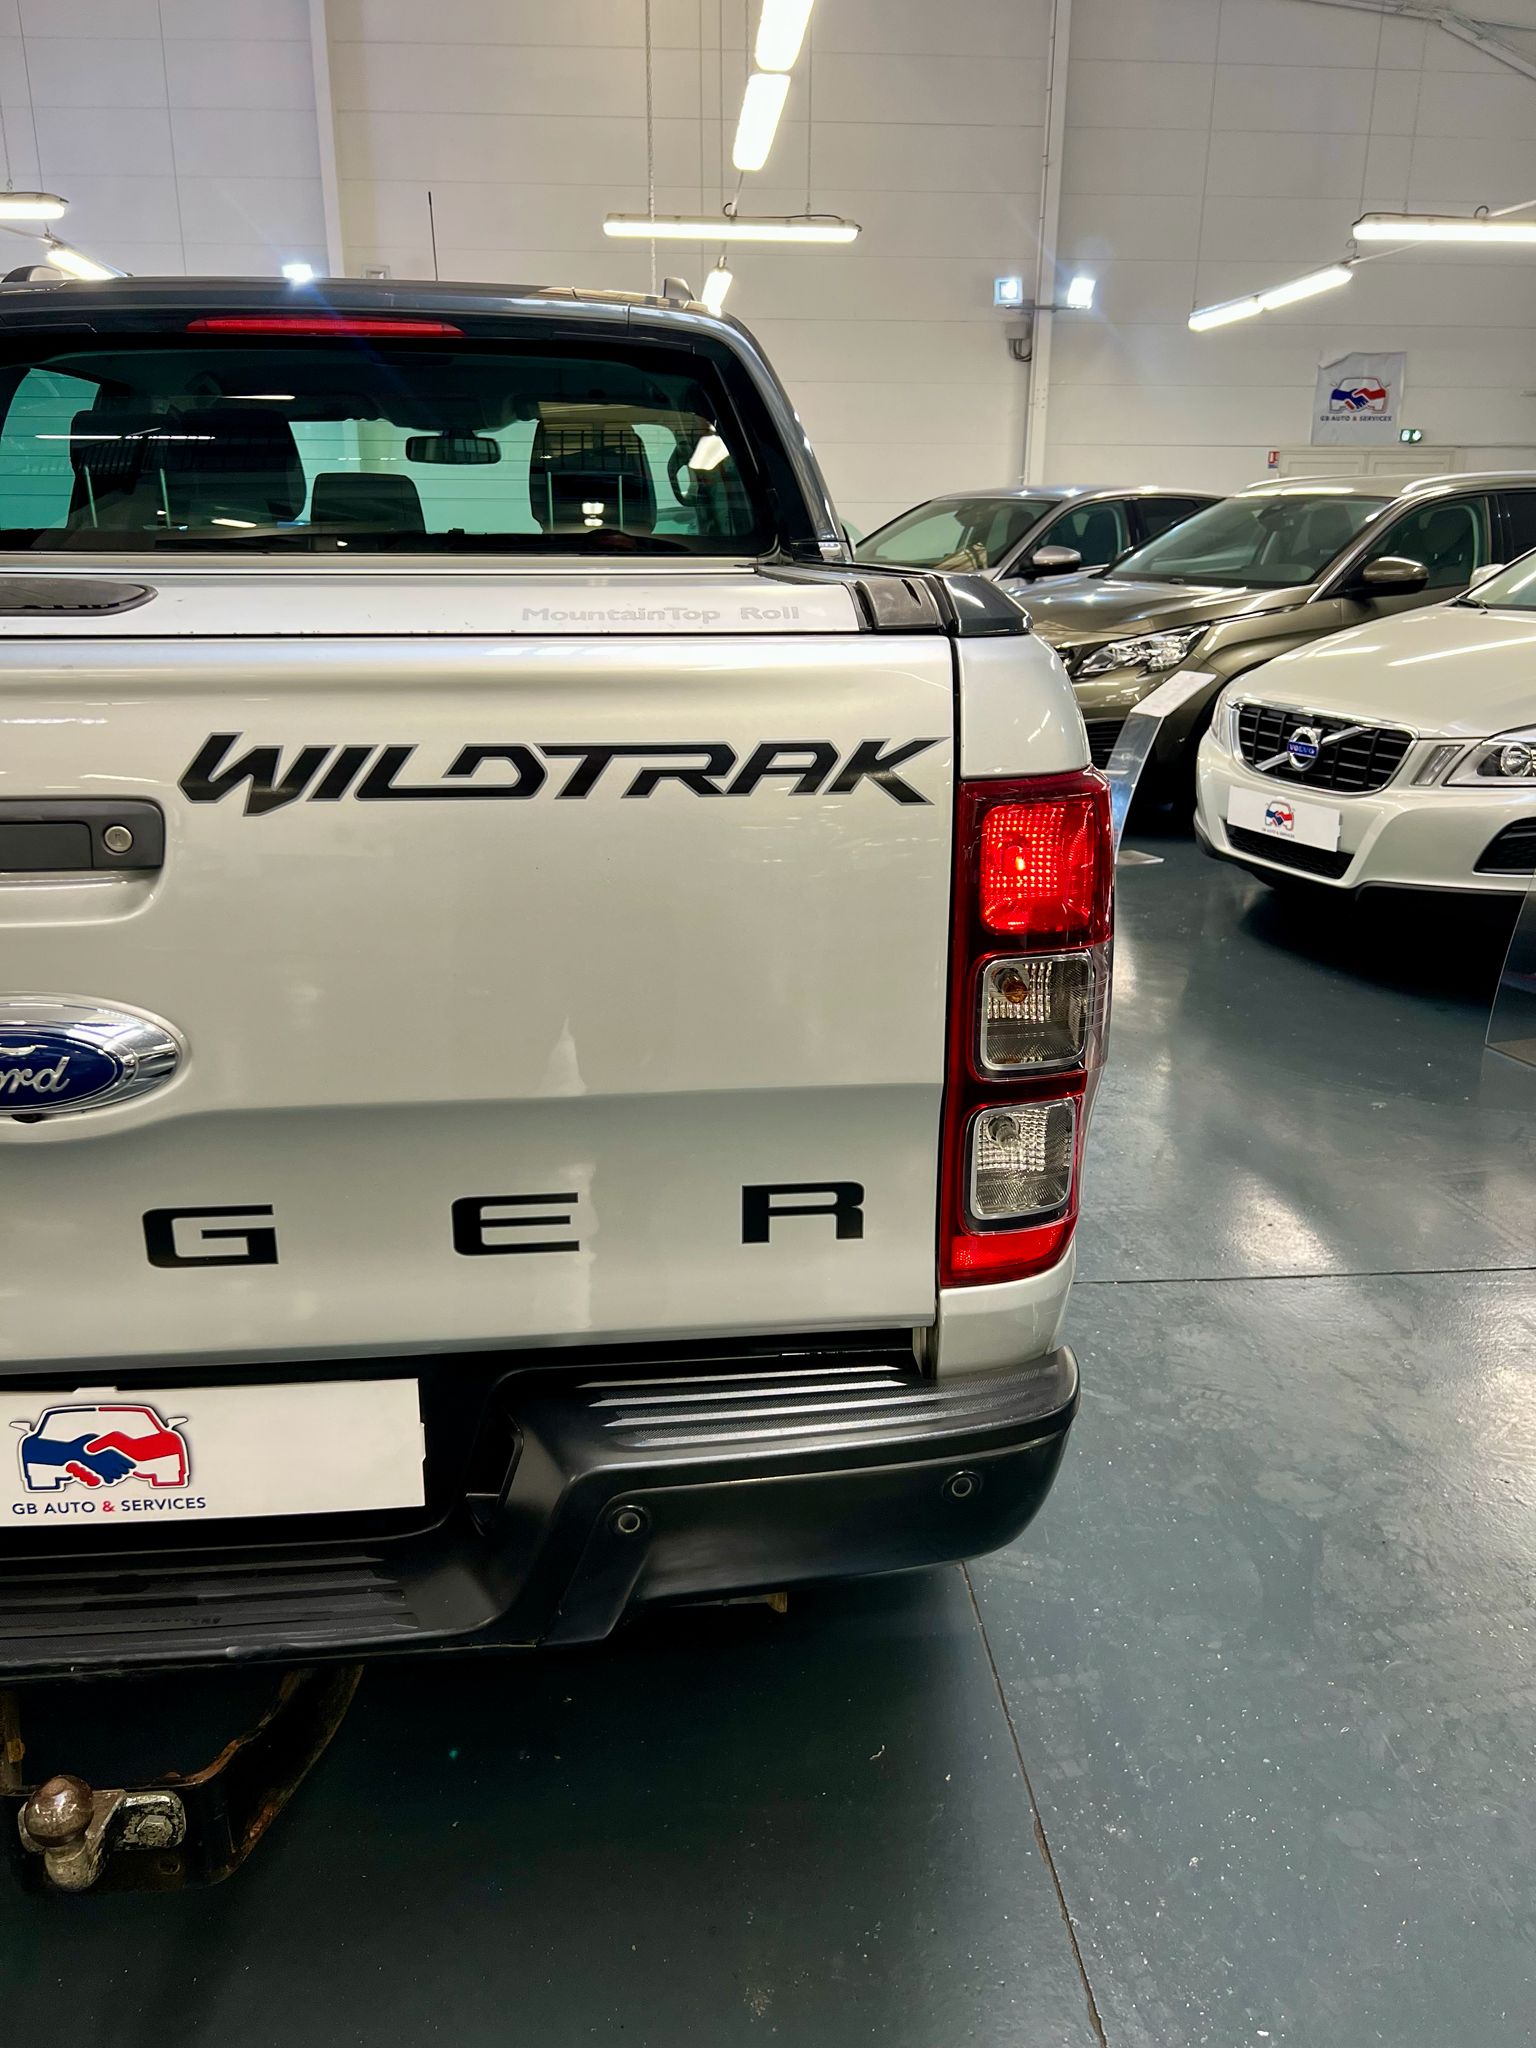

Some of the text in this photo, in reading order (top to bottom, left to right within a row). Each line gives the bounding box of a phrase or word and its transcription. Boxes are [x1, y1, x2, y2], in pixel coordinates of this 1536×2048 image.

[521, 606, 800, 624] MountainTop Roll
[1289, 744, 1316, 755] VOLVO
[177, 731, 950, 817] WILDTRAK
[12, 1497, 206, 1515] GB AUTO & SERVICES
